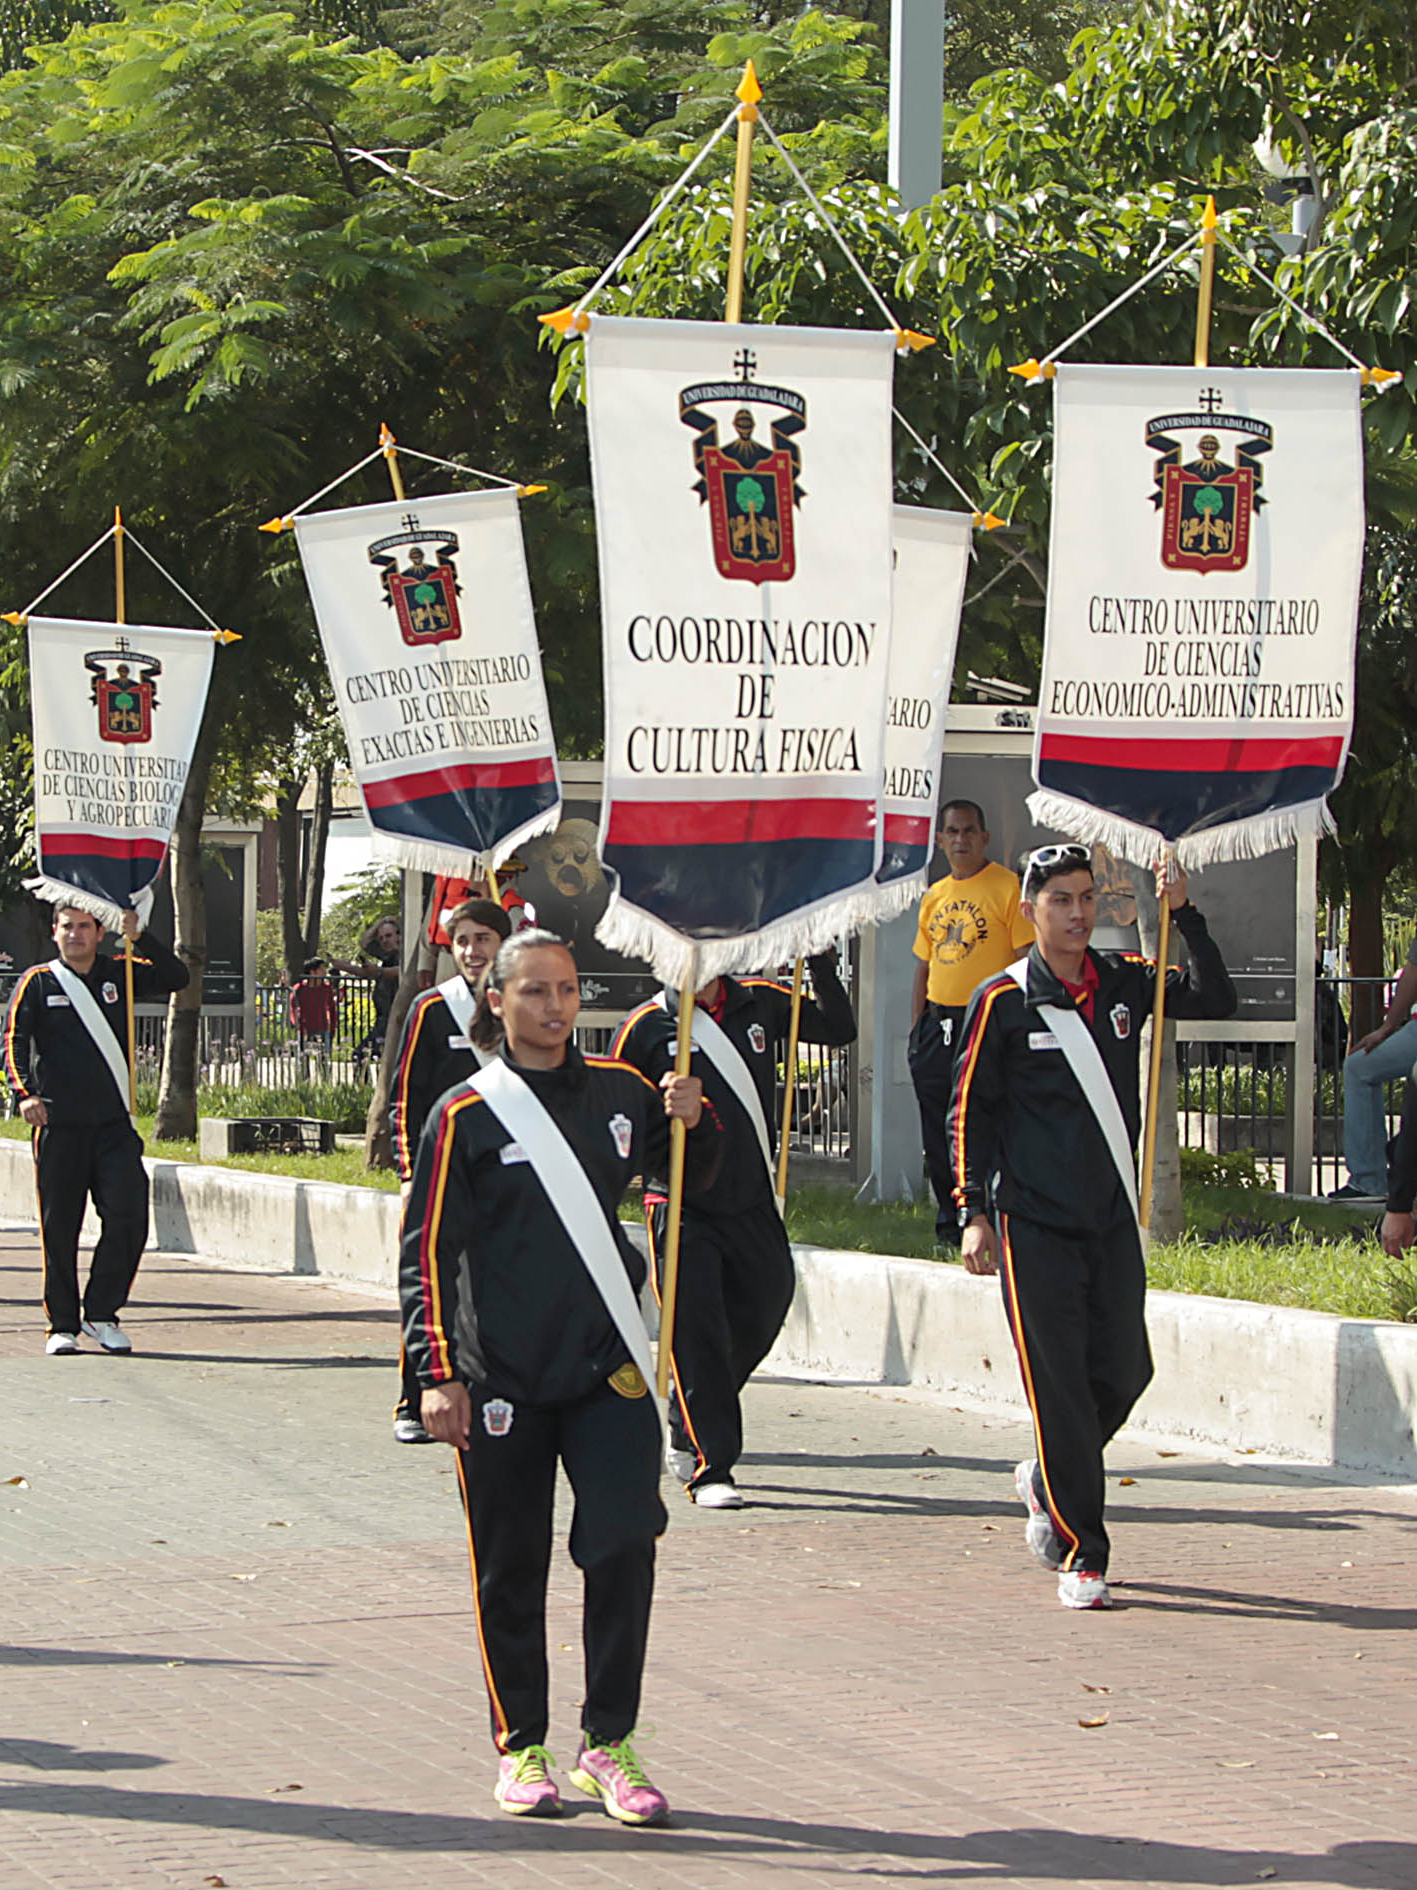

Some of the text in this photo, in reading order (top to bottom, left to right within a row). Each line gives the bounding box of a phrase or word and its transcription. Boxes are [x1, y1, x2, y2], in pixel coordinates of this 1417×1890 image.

[684, 384, 735, 404] UNIVERSIDAD
[748, 387, 804, 413] GUADALAJARA
[1149, 417, 1202, 432] UNIVERSIDAD
[1213, 417, 1270, 436] GUADALAJARA
[1089, 596, 1319, 636] CENTRO UNIVERSITARIO
[628, 615, 876, 667] COORDINACION
[1144, 641, 1262, 677] DE CIENCIAS
[346, 653, 531, 704] CENTRO UNIVERSITARIO
[736, 673, 775, 719] DE
[400, 689, 491, 725] DE CIENCIAS
[887, 696, 932, 729] ARIO
[1050, 680, 1344, 718] ECONOMICO-ADMINISTRATIVAS
[361, 714, 539, 765] EXACTAS E INGENIERIAS
[627, 726, 862, 774] CULTURA FISICA
[45, 748, 99, 775] CENTRO
[43, 774, 61, 796] DE
[64, 774, 126, 802] CIENCIAS
[884, 766, 933, 799] ADES
[67, 799, 77, 821] Y
